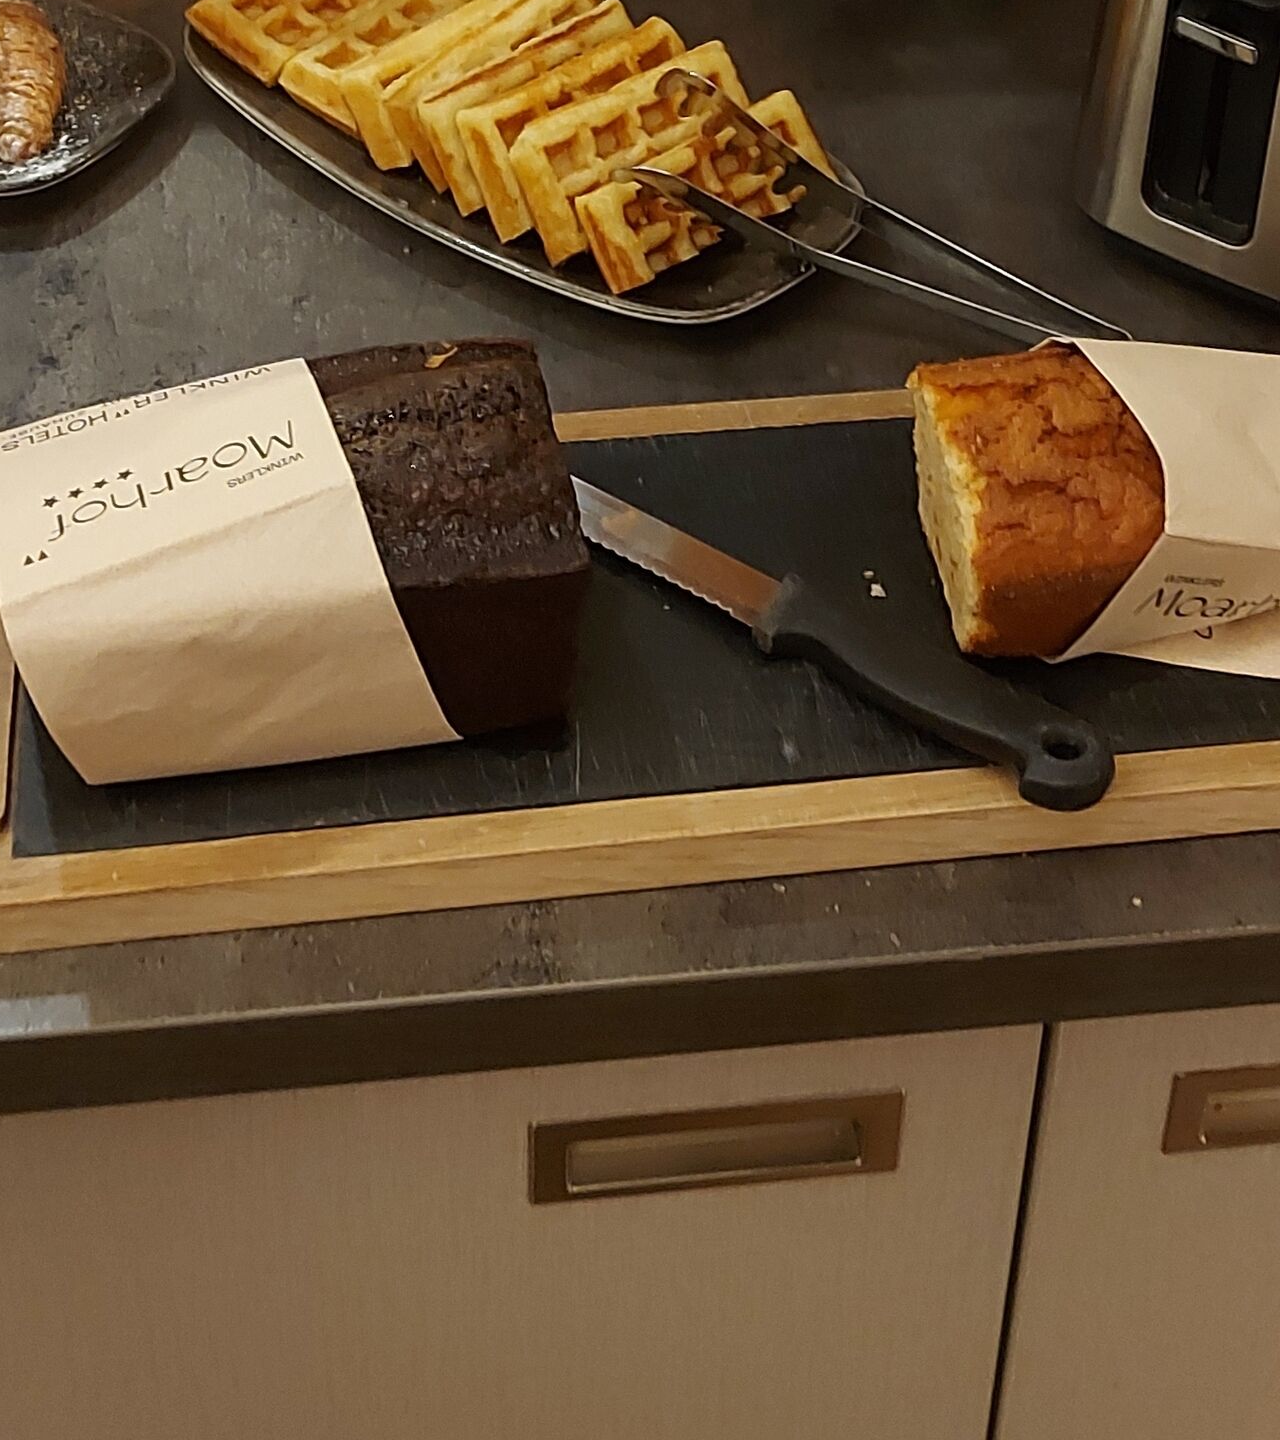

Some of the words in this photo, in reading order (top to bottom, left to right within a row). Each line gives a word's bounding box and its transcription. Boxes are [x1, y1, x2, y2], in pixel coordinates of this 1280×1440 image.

[0, 409, 109, 452] HOTELS
[47, 419, 294, 543] Moarhof
[226, 451, 305, 489] WINKLERS
